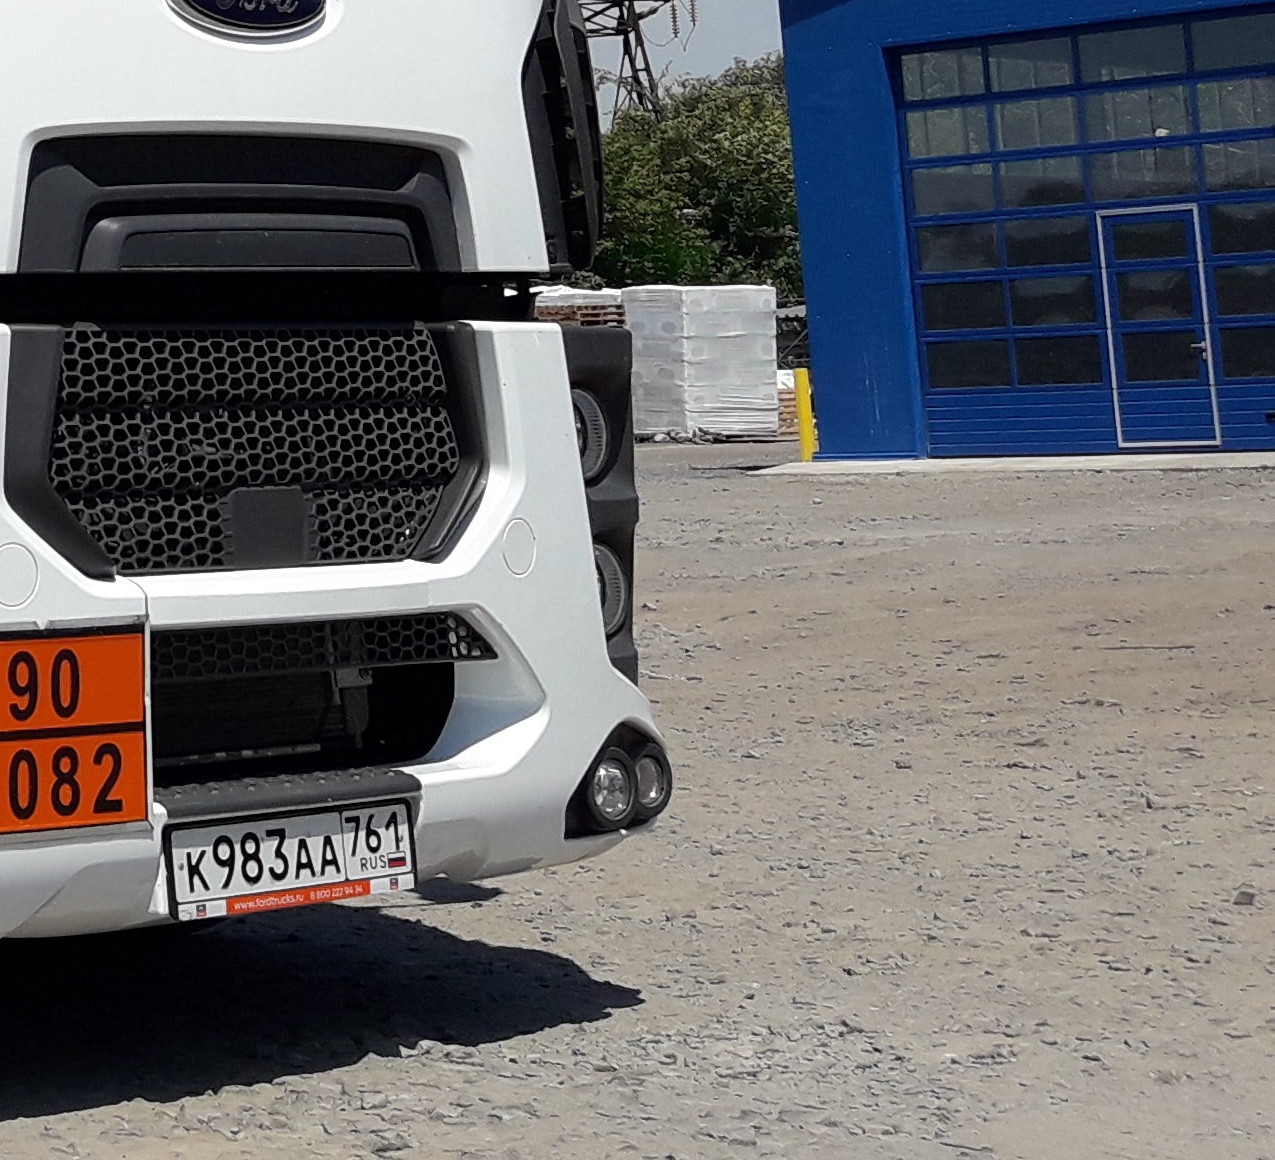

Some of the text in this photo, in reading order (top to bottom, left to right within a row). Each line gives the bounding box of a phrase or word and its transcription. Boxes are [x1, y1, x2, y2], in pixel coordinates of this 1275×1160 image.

[8, 648, 81, 722] 90
[344, 811, 402, 857] 761
[360, 854, 387, 871] RUS
